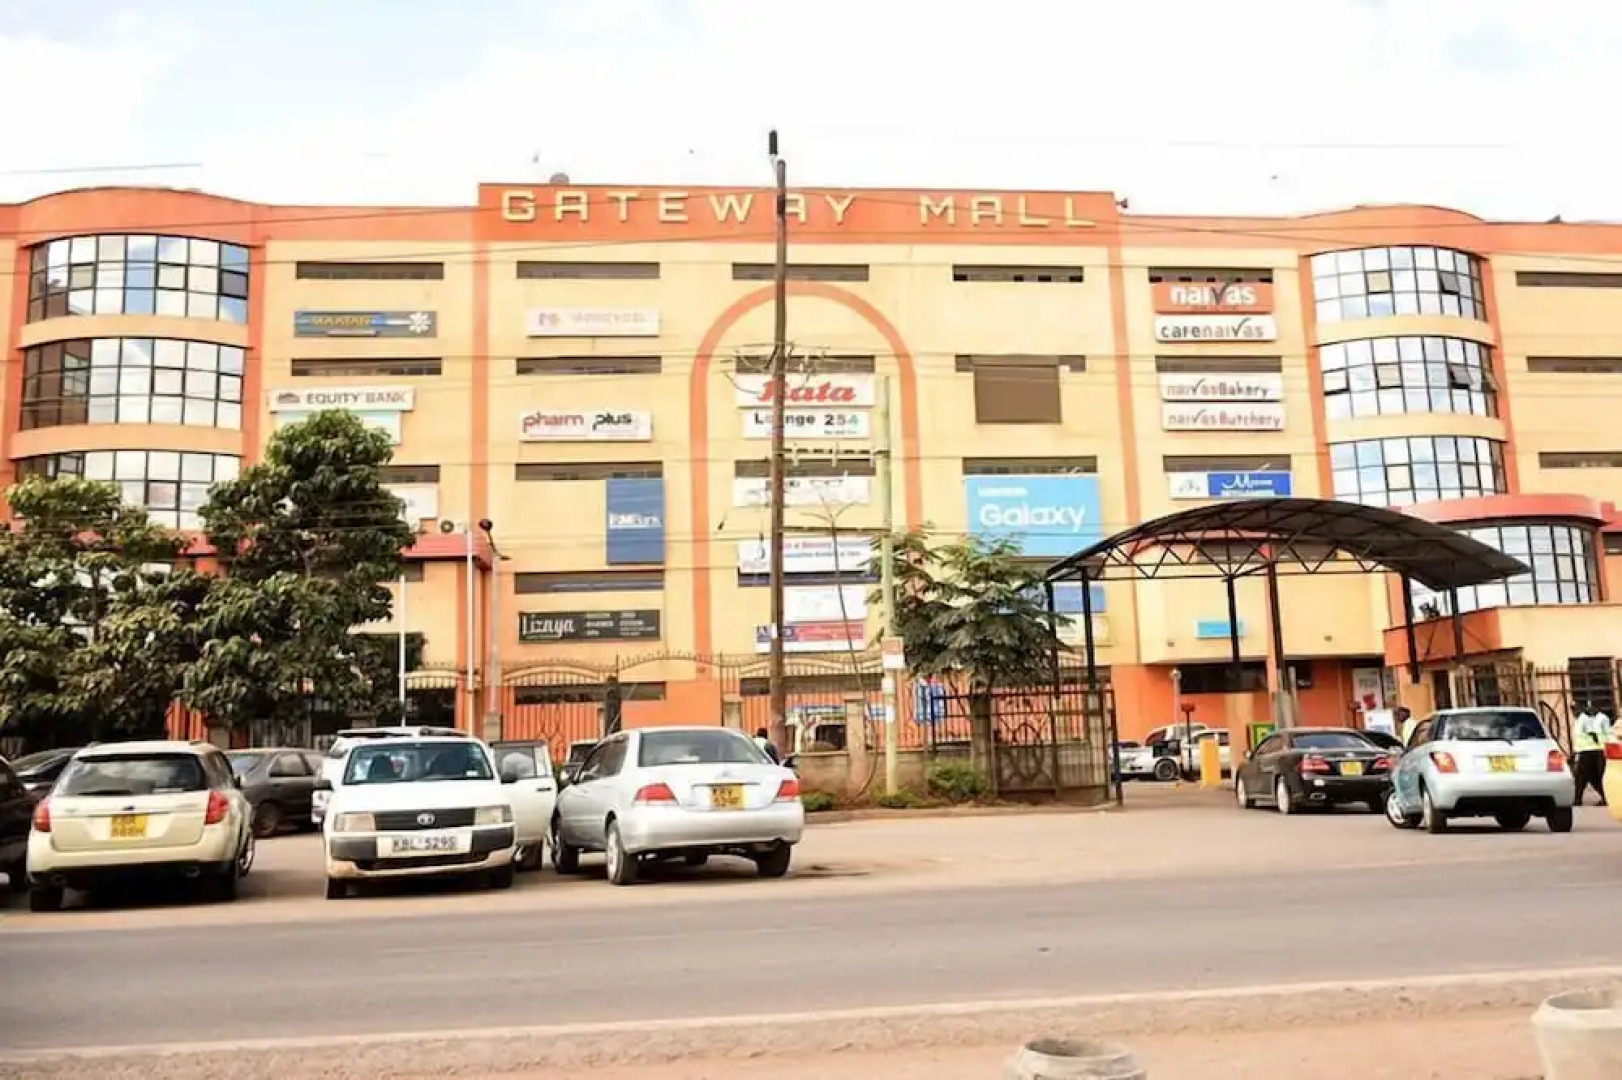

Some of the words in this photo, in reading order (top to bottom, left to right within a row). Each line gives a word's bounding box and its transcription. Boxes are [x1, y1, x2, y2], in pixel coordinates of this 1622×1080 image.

[501, 188, 857, 224] GATEWAY
[918, 194, 1097, 227] MALL
[1170, 279, 1257, 307] naivas
[306, 391, 359, 405] EQUITY
[365, 389, 406, 403] BANK
[523, 410, 584, 434] pharm
[592, 412, 632, 431] plus
[823, 414, 859, 426] 254
[979, 501, 1086, 533] Galaxy
